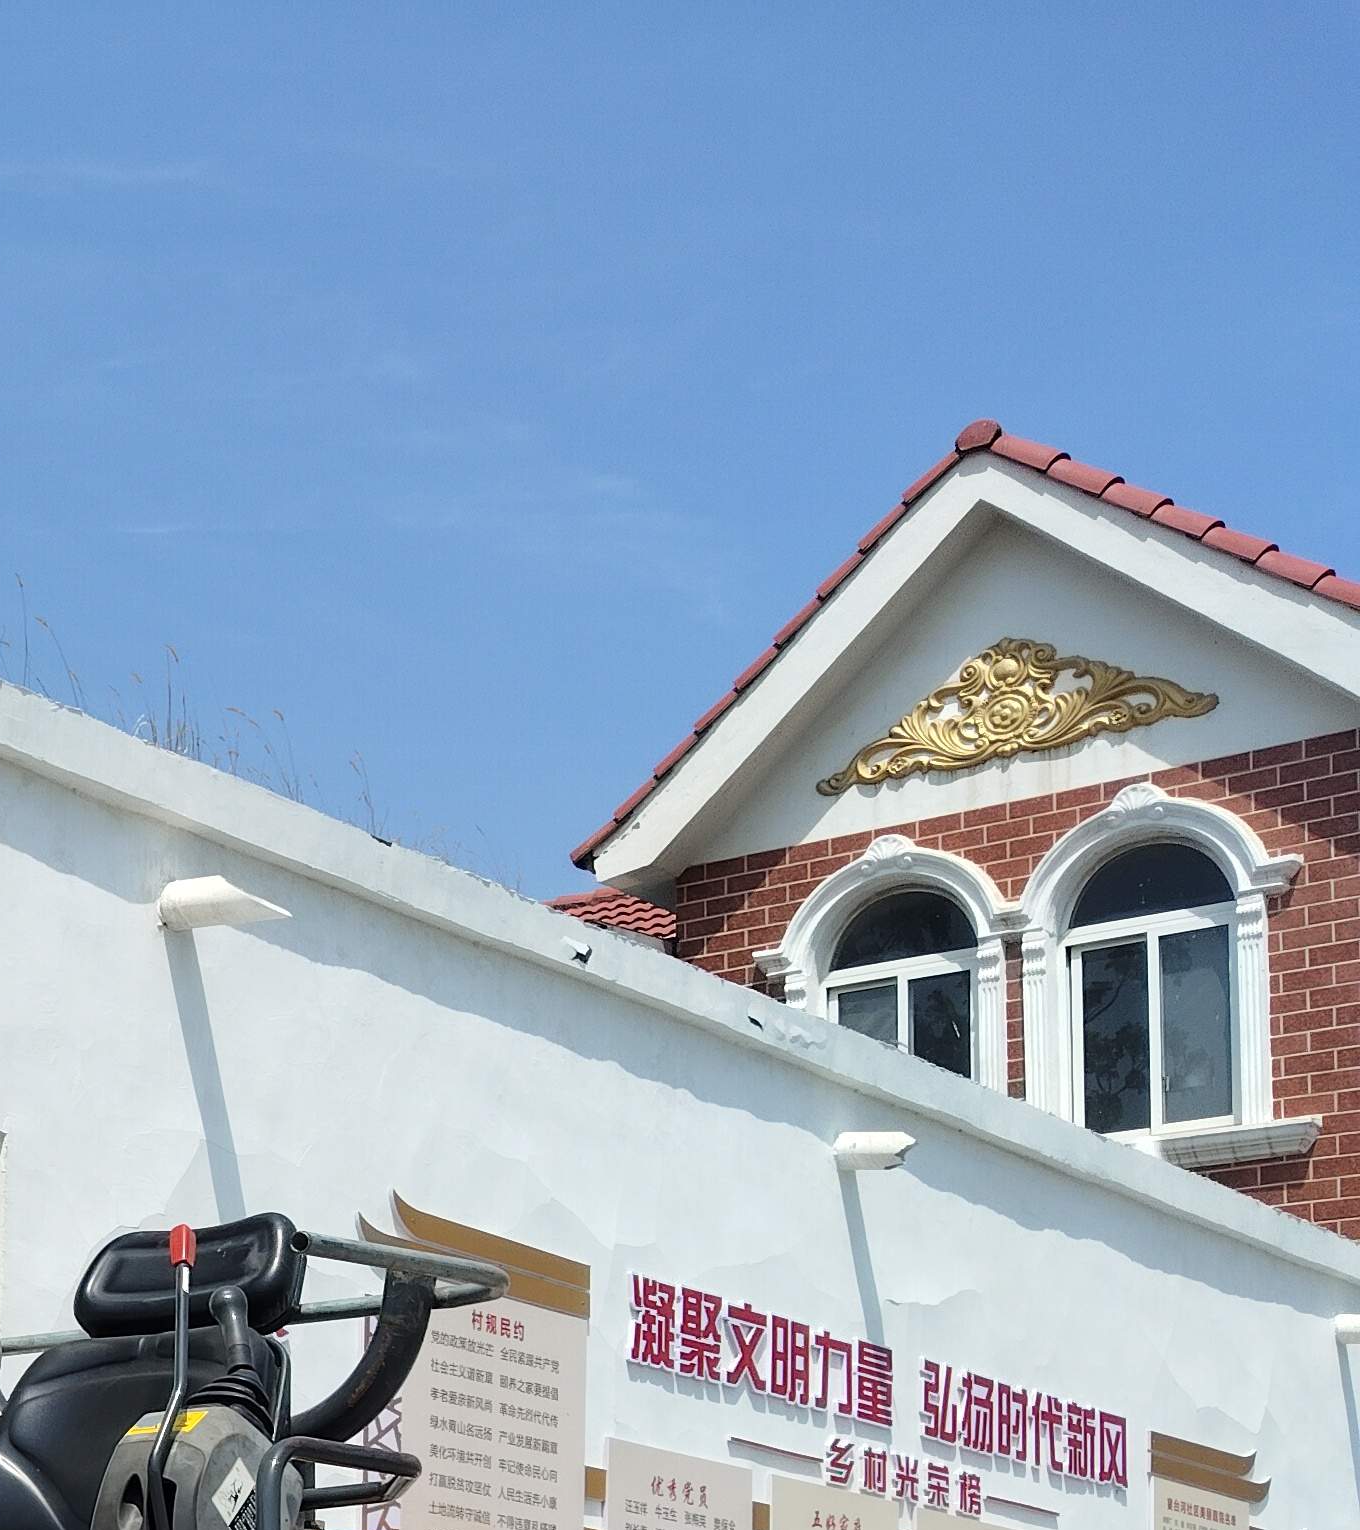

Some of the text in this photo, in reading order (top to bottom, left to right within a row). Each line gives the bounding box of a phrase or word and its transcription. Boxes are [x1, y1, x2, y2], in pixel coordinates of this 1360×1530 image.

[472, 1309, 525, 1342] 村规民约
[631, 1273, 1128, 1489] 凝聚文明力量 弘扬时代新风
[830, 1438, 982, 1516] 乡村光荣榜
